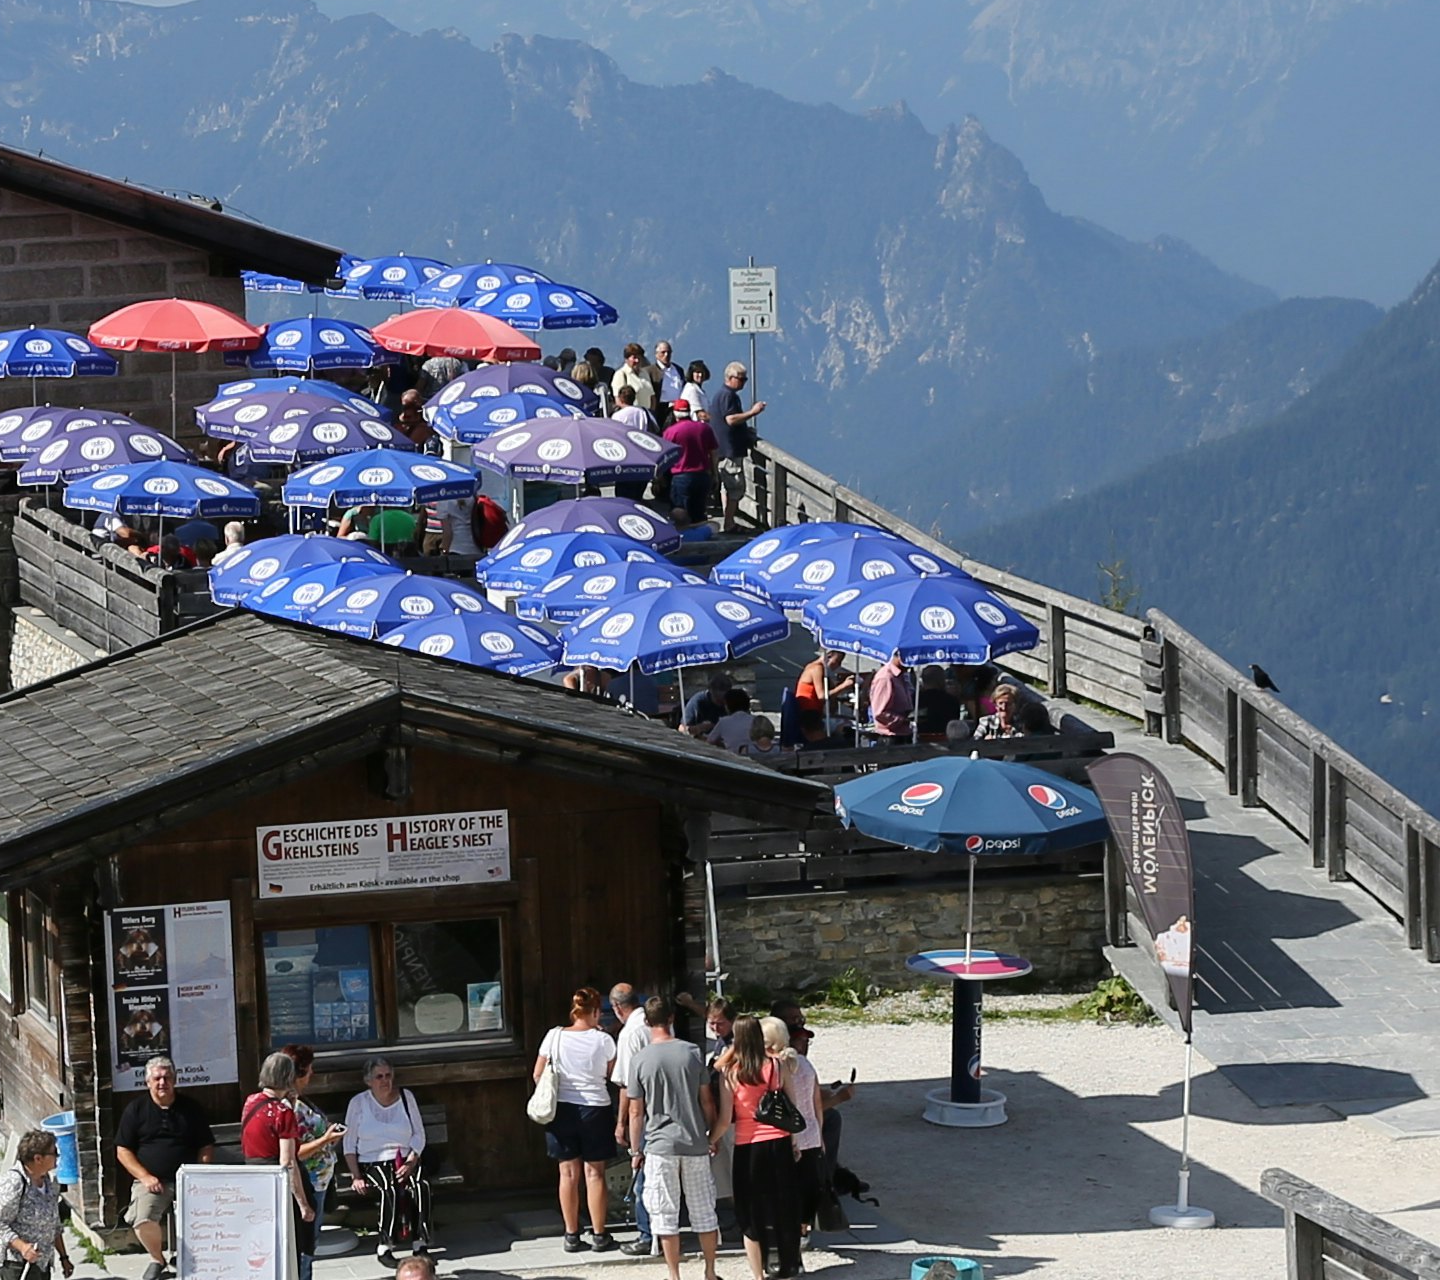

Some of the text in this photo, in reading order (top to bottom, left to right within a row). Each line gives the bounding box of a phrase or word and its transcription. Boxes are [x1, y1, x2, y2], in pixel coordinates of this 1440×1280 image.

[514, 466, 580, 476] HOFBRÄU MÜNCHEN
[378, 495, 409, 504] MÜNCHEN
[126, 503, 153, 511] HOFBRÄU
[635, 525, 648, 537] HB
[793, 583, 825, 591] MÜNCHEN
[868, 613, 882, 622] HB
[987, 612, 1000, 621] HB
[931, 618, 946, 628] HB
[848, 624, 880, 636] MÜNCHEN
[661, 635, 698, 646] MÜNCHEN
[825, 639, 889, 660] HOFBRÄU MÜNCHEN
[686, 652, 721, 661] MÜNCHEN
[944, 652, 980, 660] MÜNCHEN
[888, 803, 925, 817] pepsi
[387, 815, 503, 852] HISTORY OF THE
[262, 824, 378, 861] GESCHICHTE DES
[462, 833, 493, 847] NEST
[985, 838, 1021, 849] pepsi
[284, 842, 359, 860] KEHLSTEINS
[310, 882, 344, 891] Erhältlich
[360, 878, 379, 888] Kiosk
[385, 876, 418, 886] available
[420, 876, 427, 884] at
[428, 874, 440, 883] the
[442, 874, 460, 884] shop
[142, 916, 155, 924] Berg
[192, 1075, 210, 1084] shop
